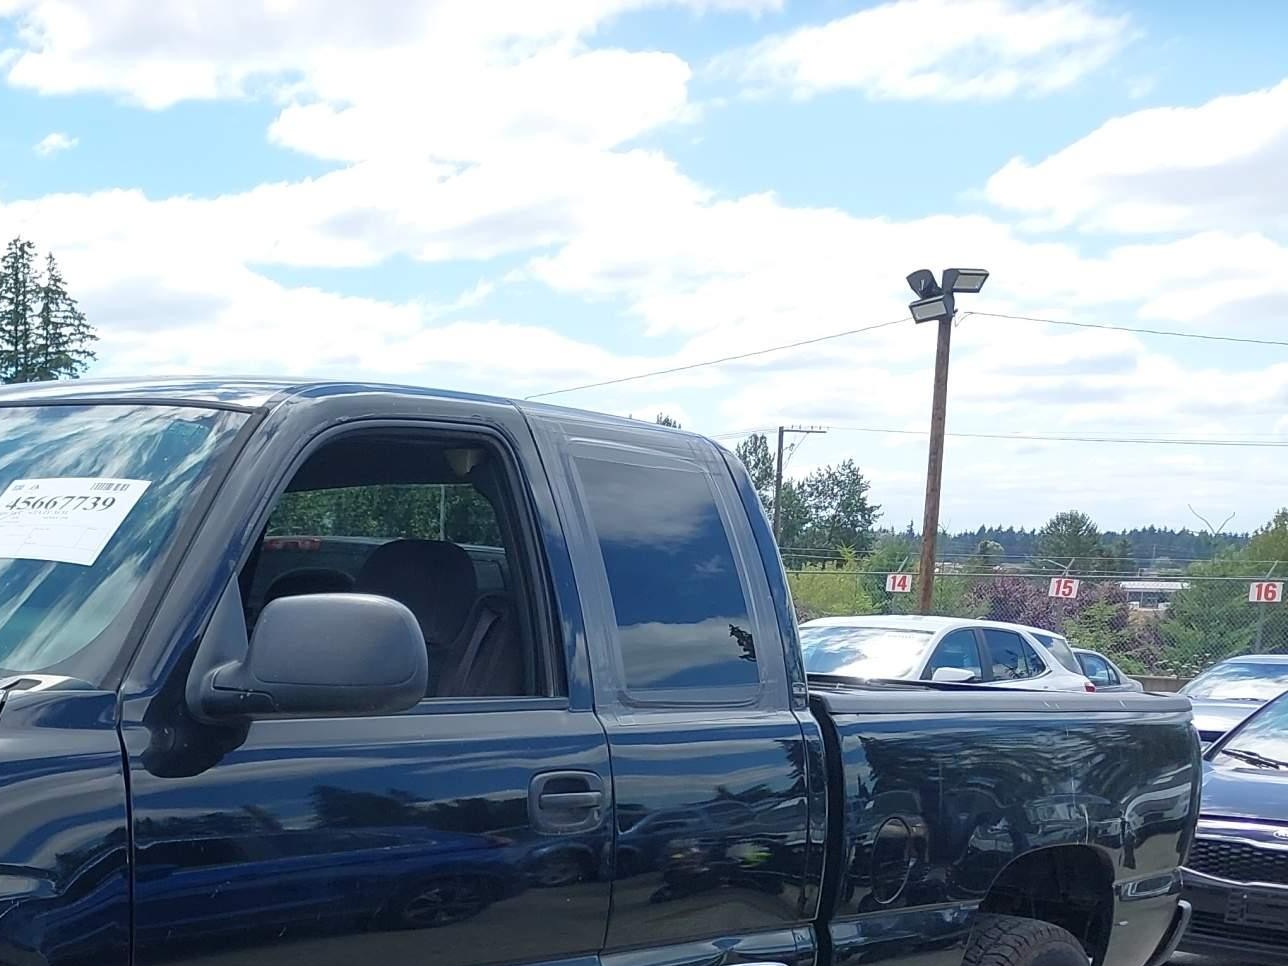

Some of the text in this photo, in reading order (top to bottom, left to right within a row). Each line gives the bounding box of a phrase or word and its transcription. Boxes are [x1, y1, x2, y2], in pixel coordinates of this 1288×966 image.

[5, 495, 117, 512] 45667739
[891, 575, 908, 591] 14
[1055, 579, 1075, 597] 15
[1255, 582, 1278, 601] 16
